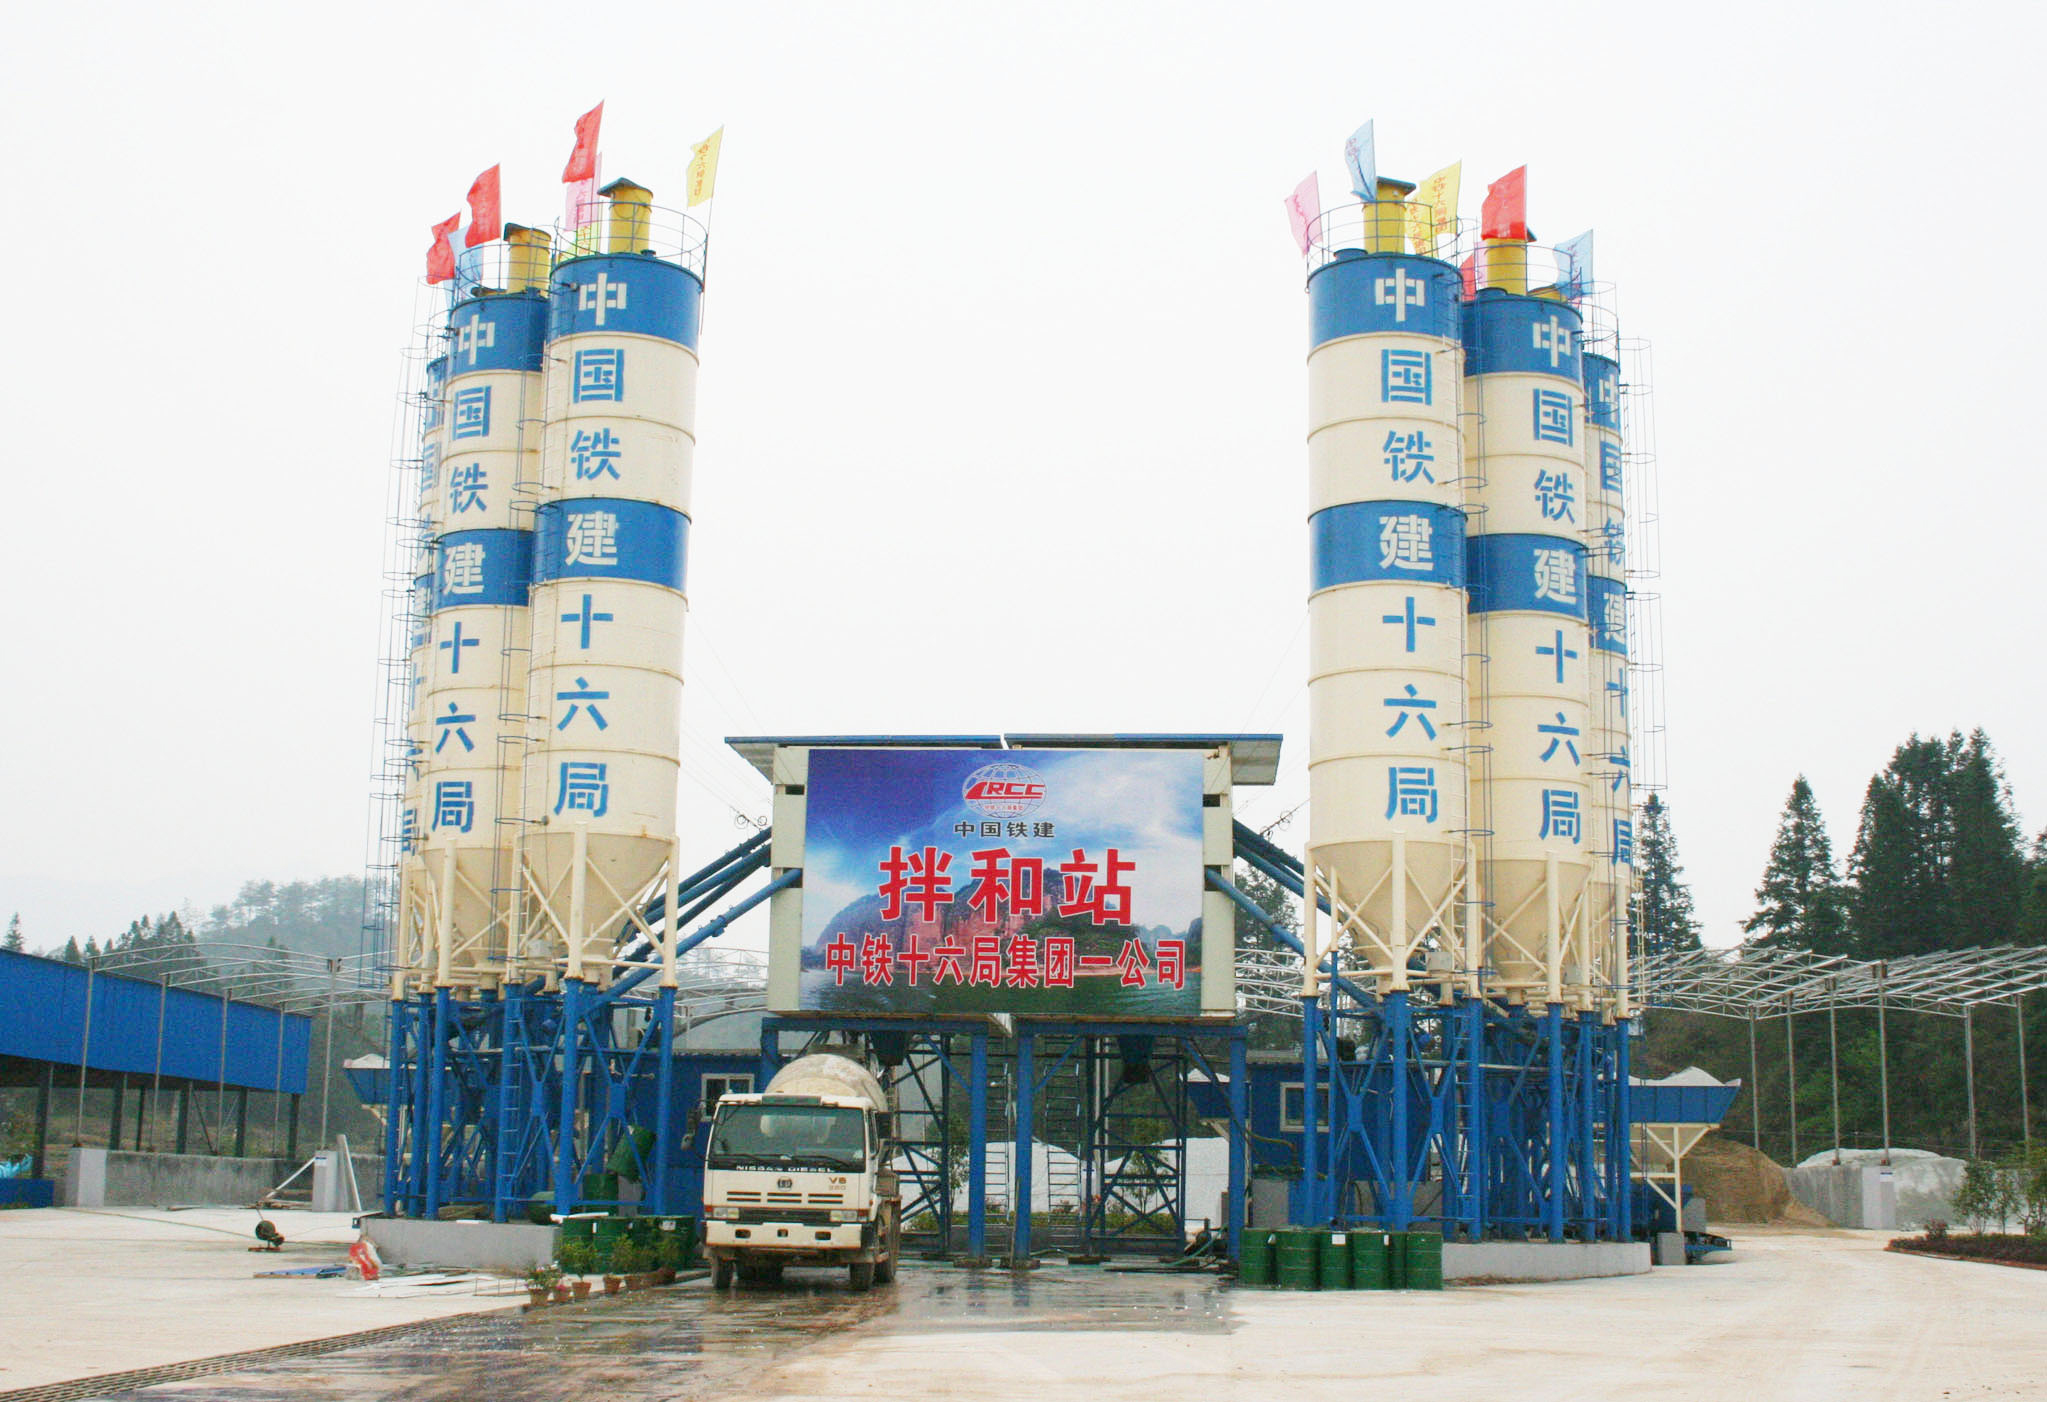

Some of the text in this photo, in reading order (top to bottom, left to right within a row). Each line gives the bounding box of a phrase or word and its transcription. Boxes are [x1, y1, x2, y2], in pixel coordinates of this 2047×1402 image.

[431, 314, 497, 834] 中国铁建十六局
[553, 272, 627, 818] 中国铁建十六局
[1375, 267, 1438, 823] 中国铁建十六局
[1532, 315, 1581, 845] 中国铁建十六局
[825, 932, 1186, 990] 中铁十六局集团一公司
[879, 845, 1137, 926] 拌和站
[954, 821, 1055, 838] 中国铁建
